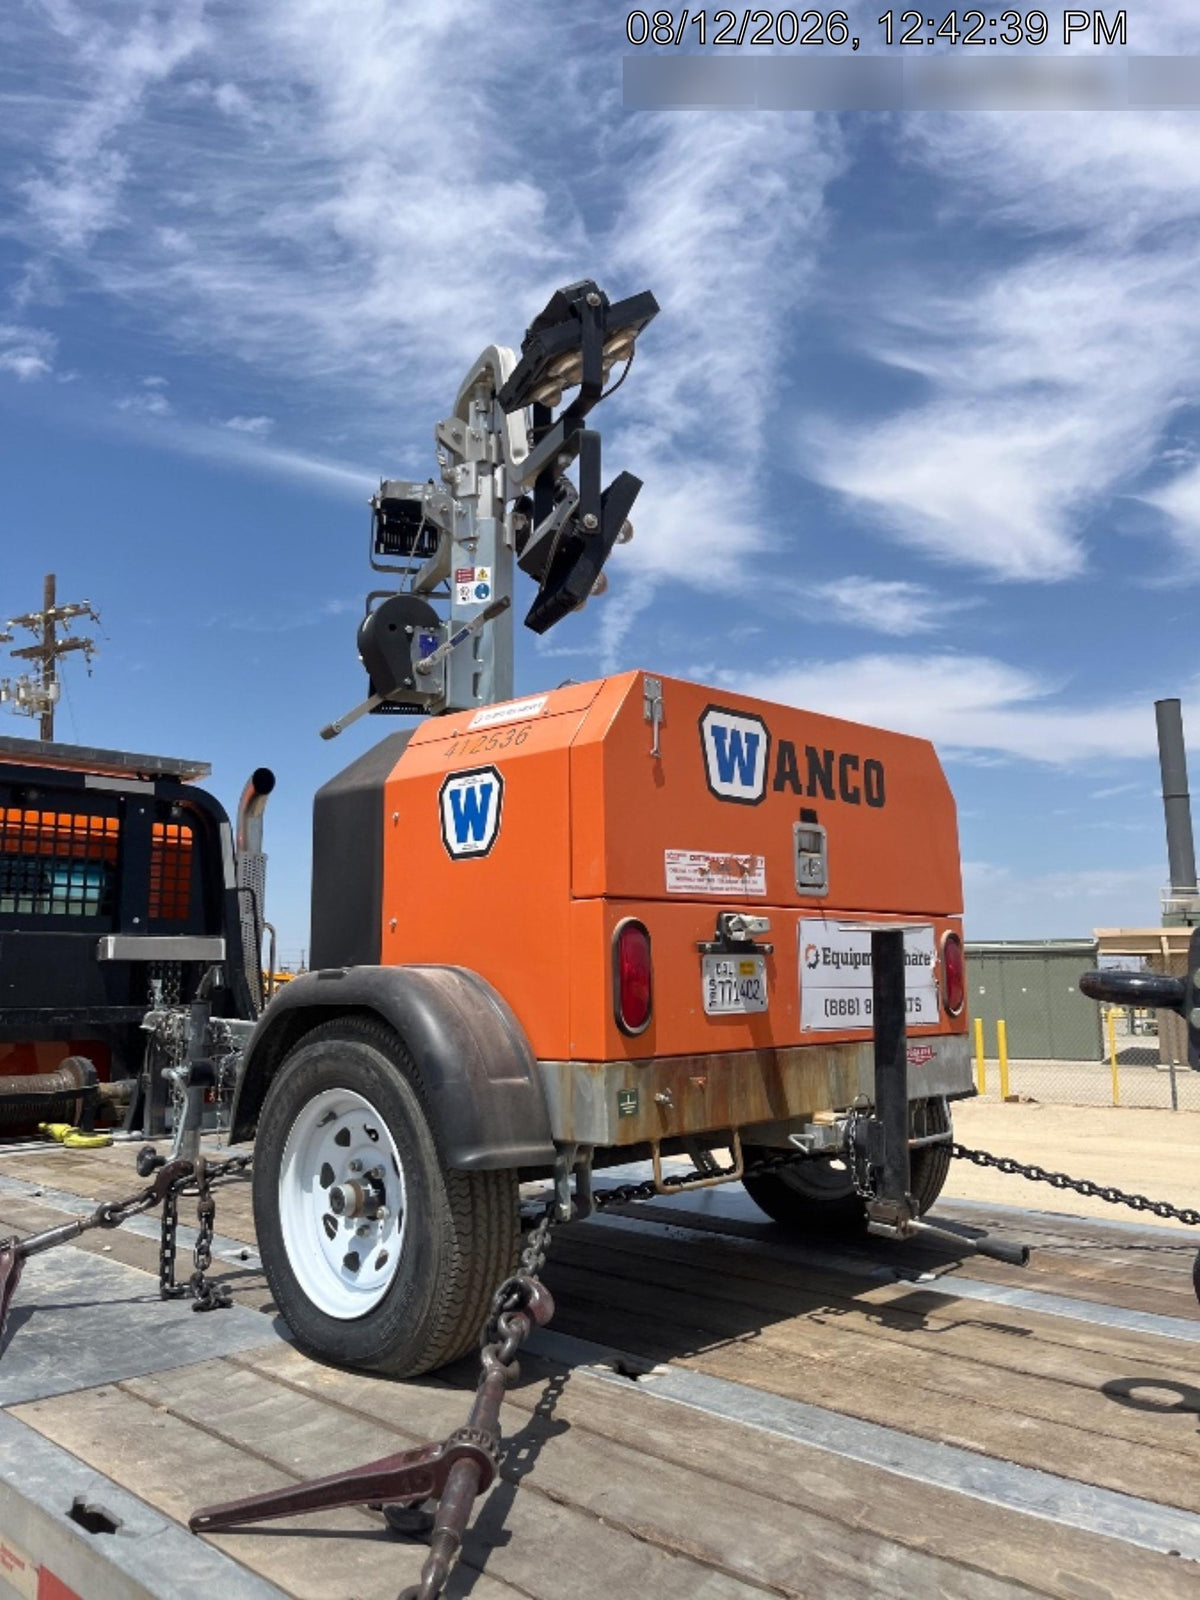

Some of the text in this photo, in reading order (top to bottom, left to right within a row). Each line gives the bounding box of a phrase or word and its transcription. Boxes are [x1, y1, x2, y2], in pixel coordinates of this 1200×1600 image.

[710, 724, 886, 808] WANCO
[449, 782, 493, 844] W
[820, 946, 931, 970] Equipmhare
